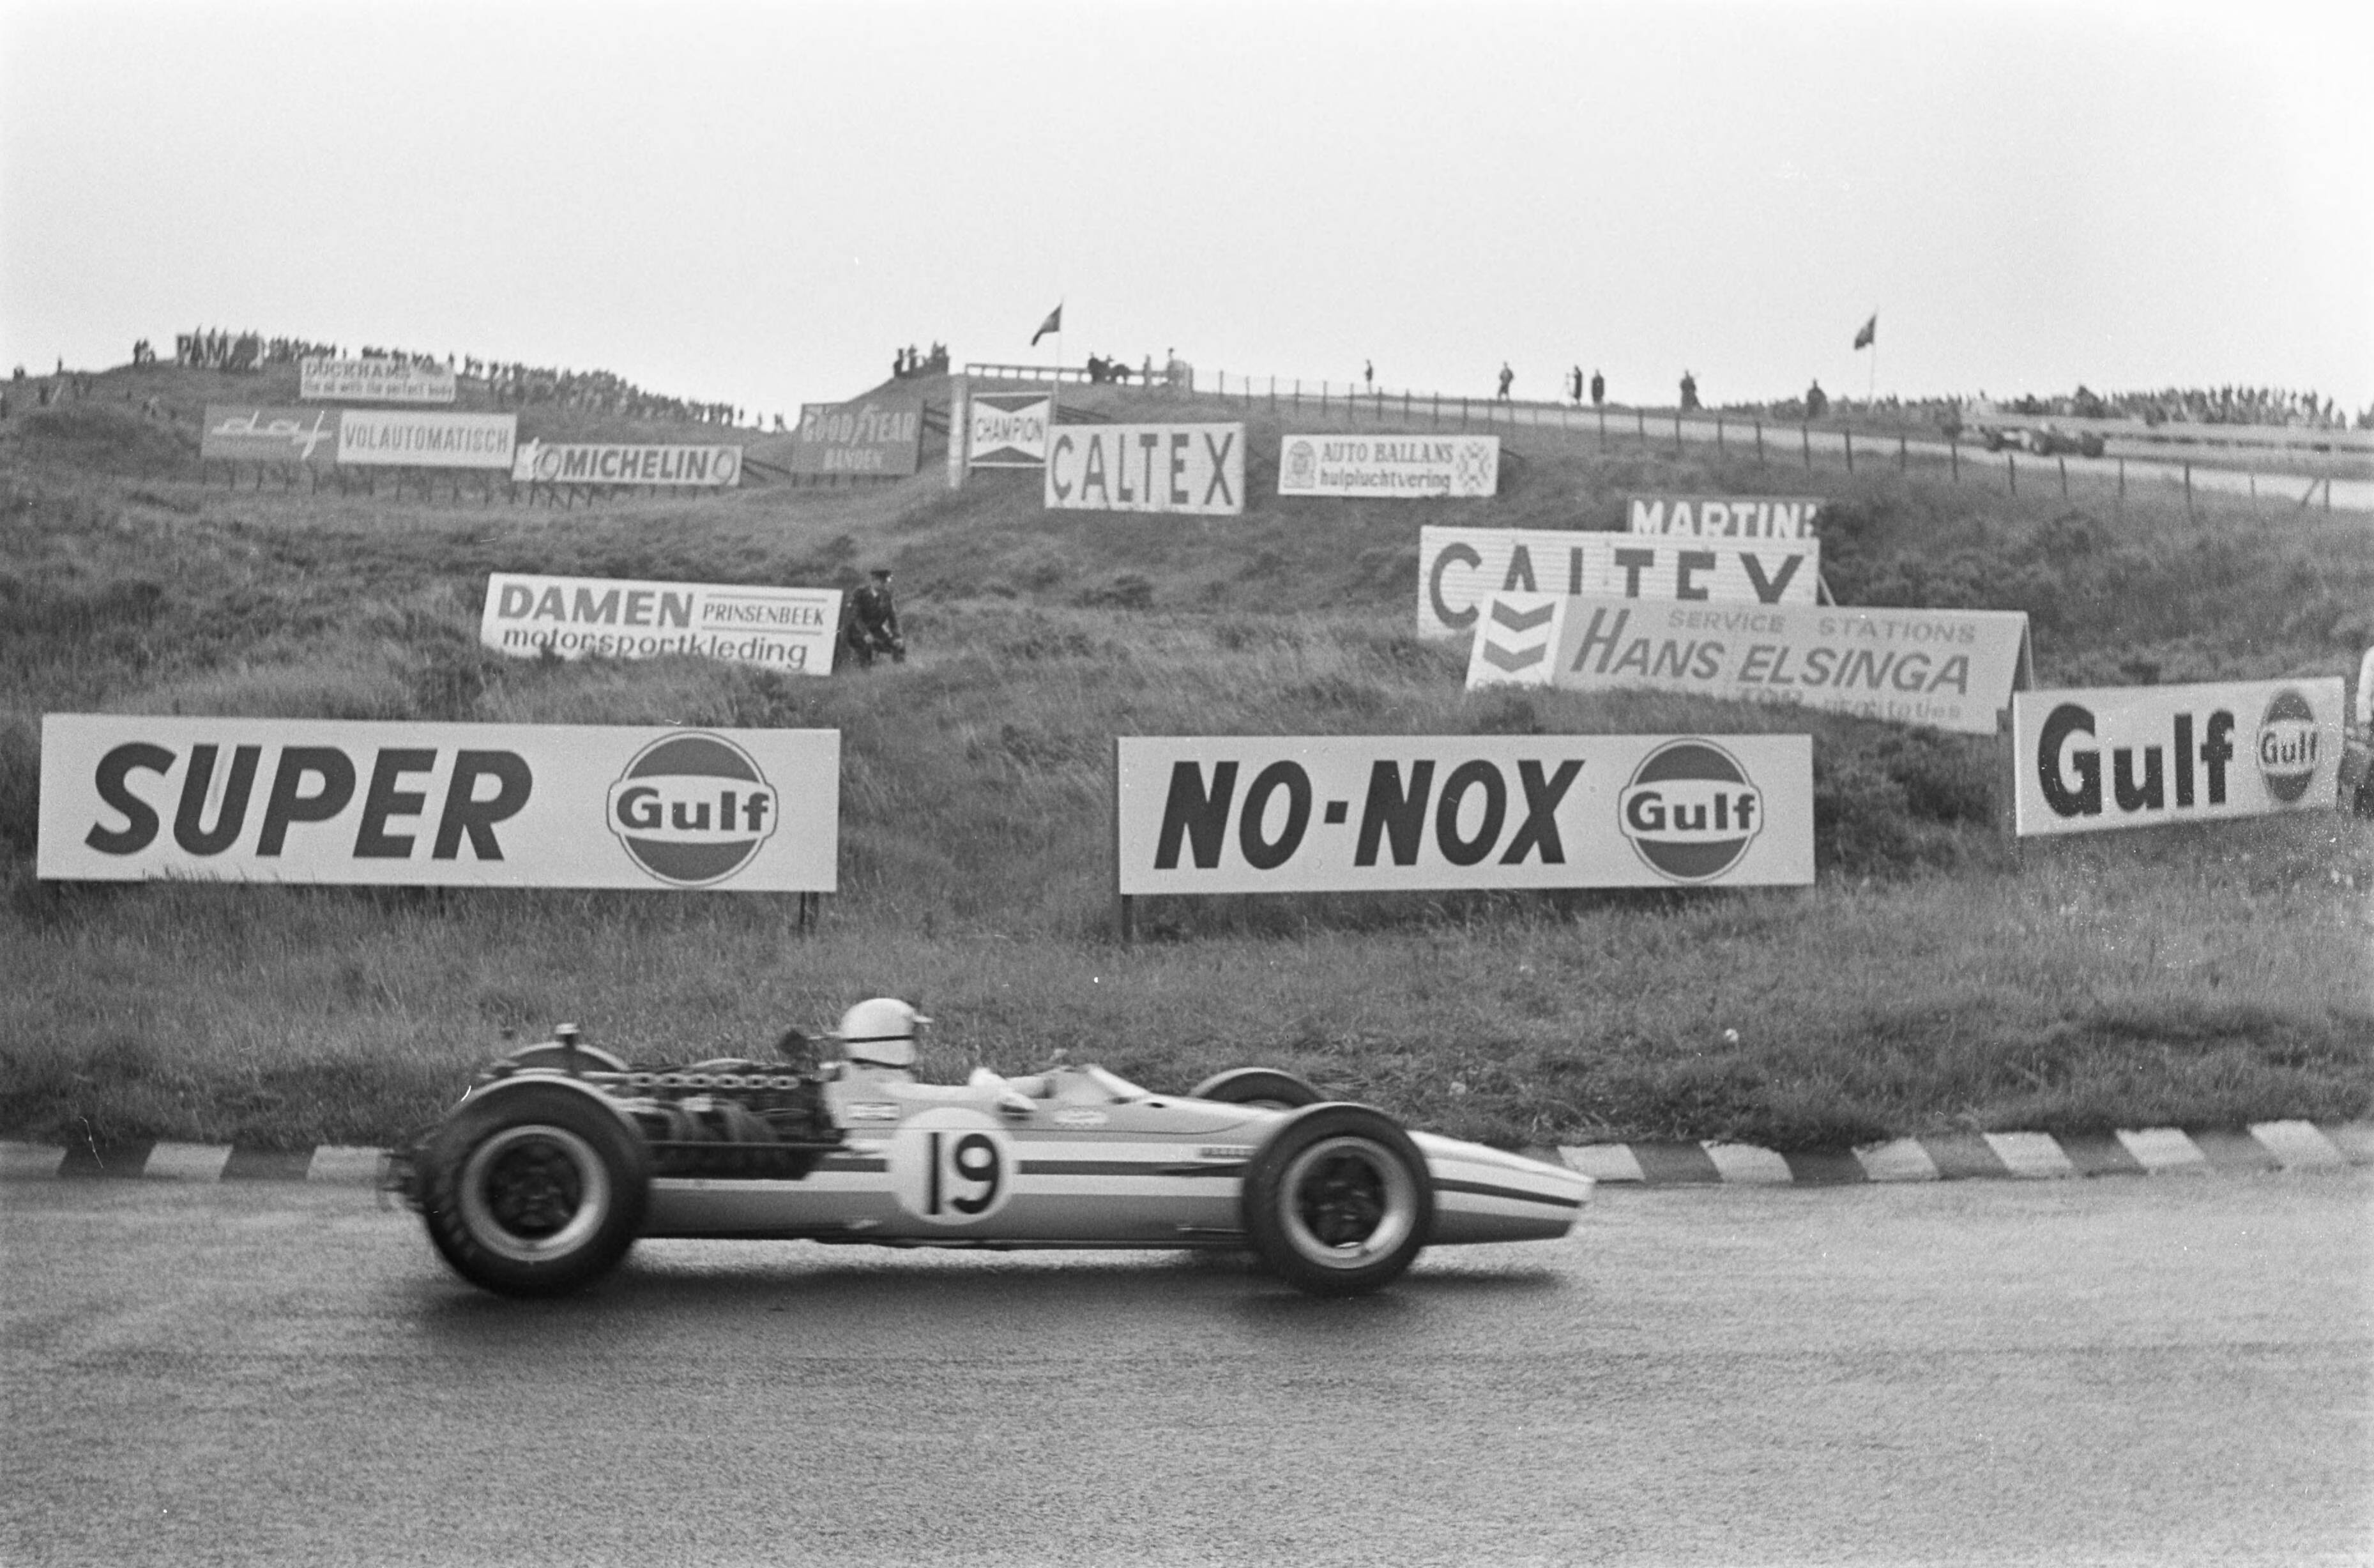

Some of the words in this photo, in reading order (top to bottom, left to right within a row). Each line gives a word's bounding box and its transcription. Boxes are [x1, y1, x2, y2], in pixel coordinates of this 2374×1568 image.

[344, 423, 510, 453] VOLAUTOMATISCH
[977, 417, 1044, 442] CHAMPION
[563, 448, 708, 480] MICHELIN
[1051, 432, 1235, 506] CALTEX
[1321, 443, 1368, 463] AUTO
[1374, 443, 1454, 464] BALLANS
[498, 583, 695, 628] DAMEN
[703, 602, 825, 627] PRINSENBEEK
[1667, 609, 1786, 634] SERVICE
[1818, 616, 1975, 644] STATIONS
[503, 626, 809, 670] motorsportkleding
[1571, 606, 1725, 680] HANS
[1737, 644, 1970, 696] ELSINGA
[2038, 703, 2235, 818] Gulf
[2261, 731, 2318, 765] Gulf
[84, 742, 533, 862] SUPER
[614, 786, 770, 832] Gulf
[1153, 759, 1586, 871] NO-NOX
[1626, 791, 1755, 831] Gulf
[928, 1132, 1001, 1215] 19
